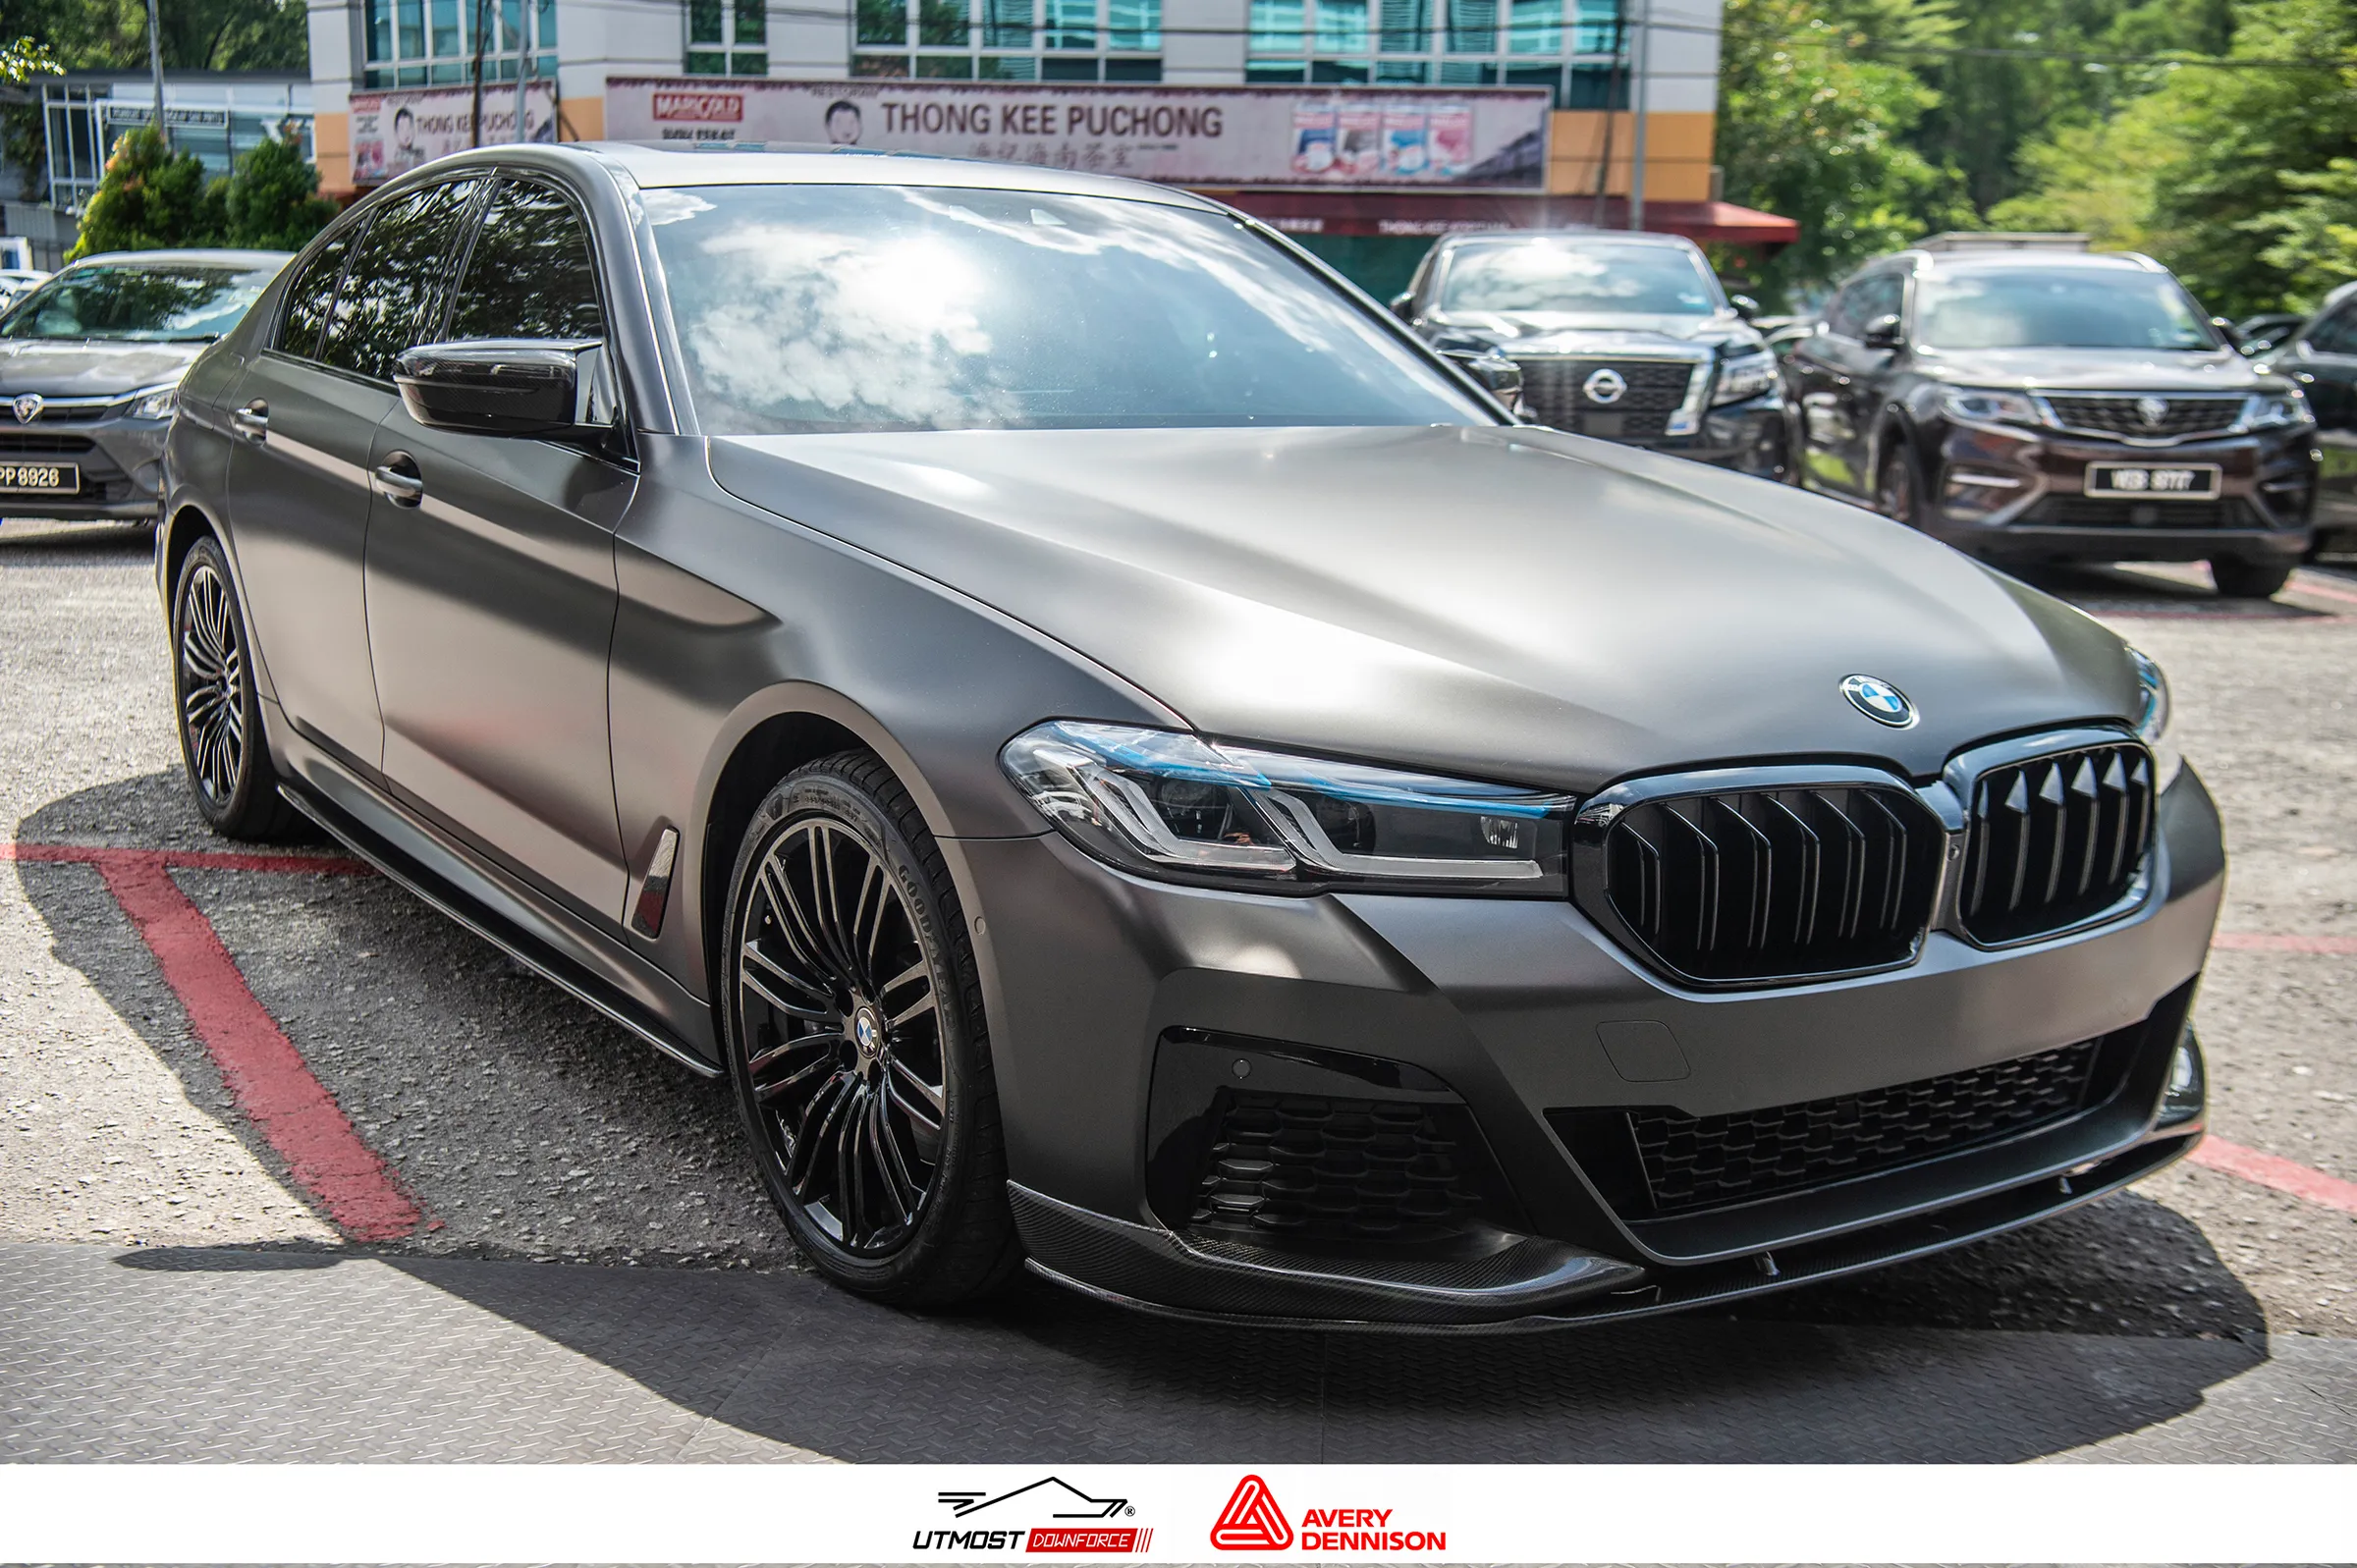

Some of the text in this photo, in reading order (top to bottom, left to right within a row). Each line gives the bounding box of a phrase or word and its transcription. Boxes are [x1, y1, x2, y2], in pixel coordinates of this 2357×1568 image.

[416, 115, 454, 134] THONG
[881, 103, 1224, 137] THONG KEE PUCHONG
